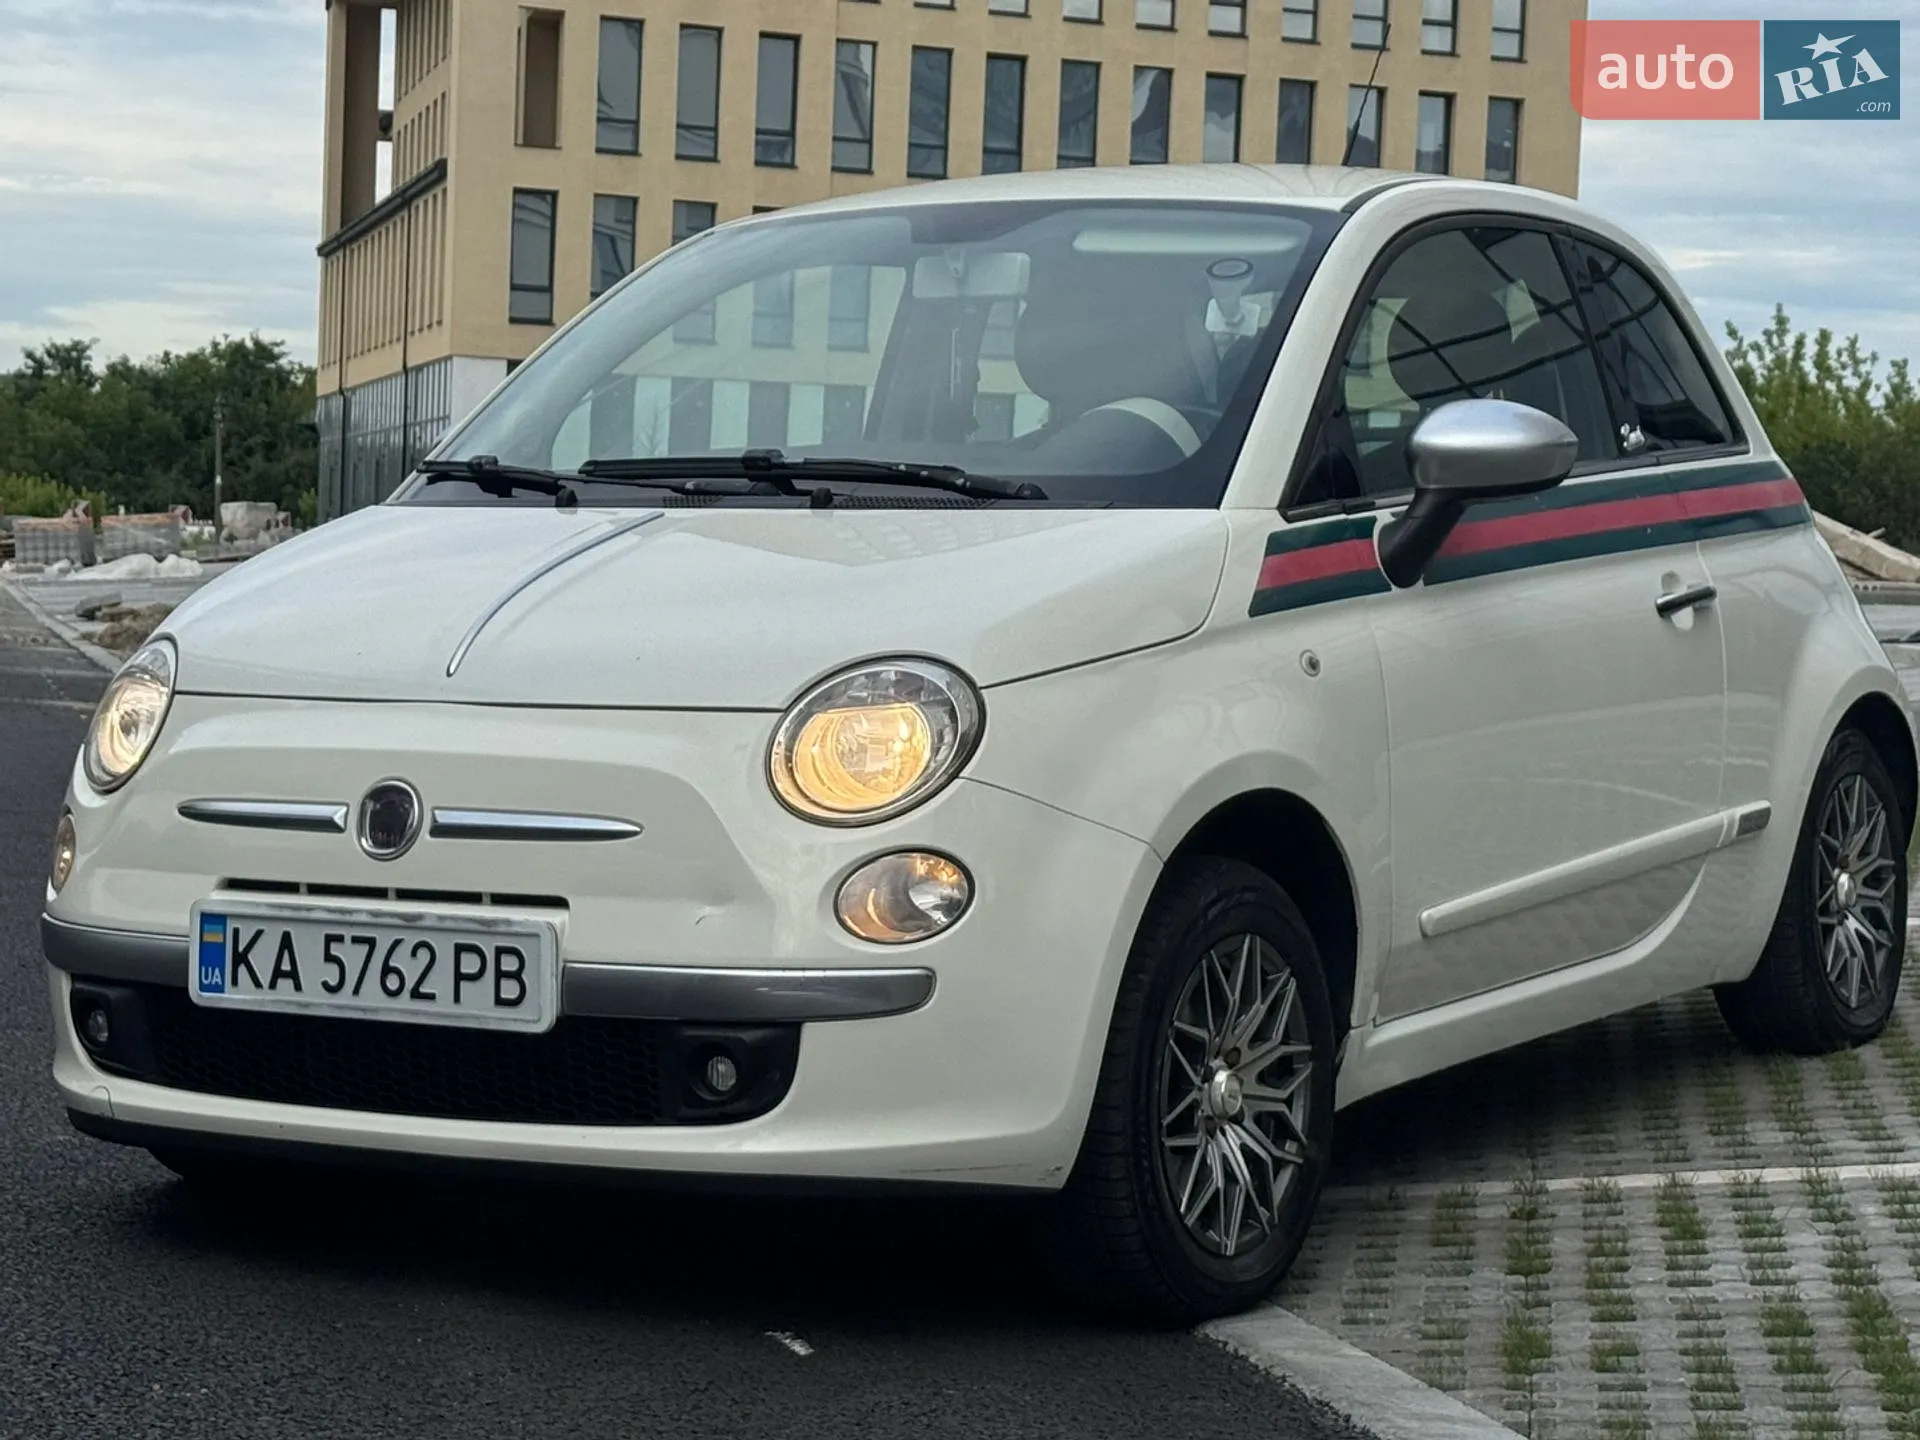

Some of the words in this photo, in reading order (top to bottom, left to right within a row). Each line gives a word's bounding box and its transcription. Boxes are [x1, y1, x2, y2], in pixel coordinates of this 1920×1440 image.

[201, 966, 223, 985] UA
[231, 926, 303, 992] KA
[321, 933, 437, 1000] 5762
[452, 942, 527, 1007] PB
